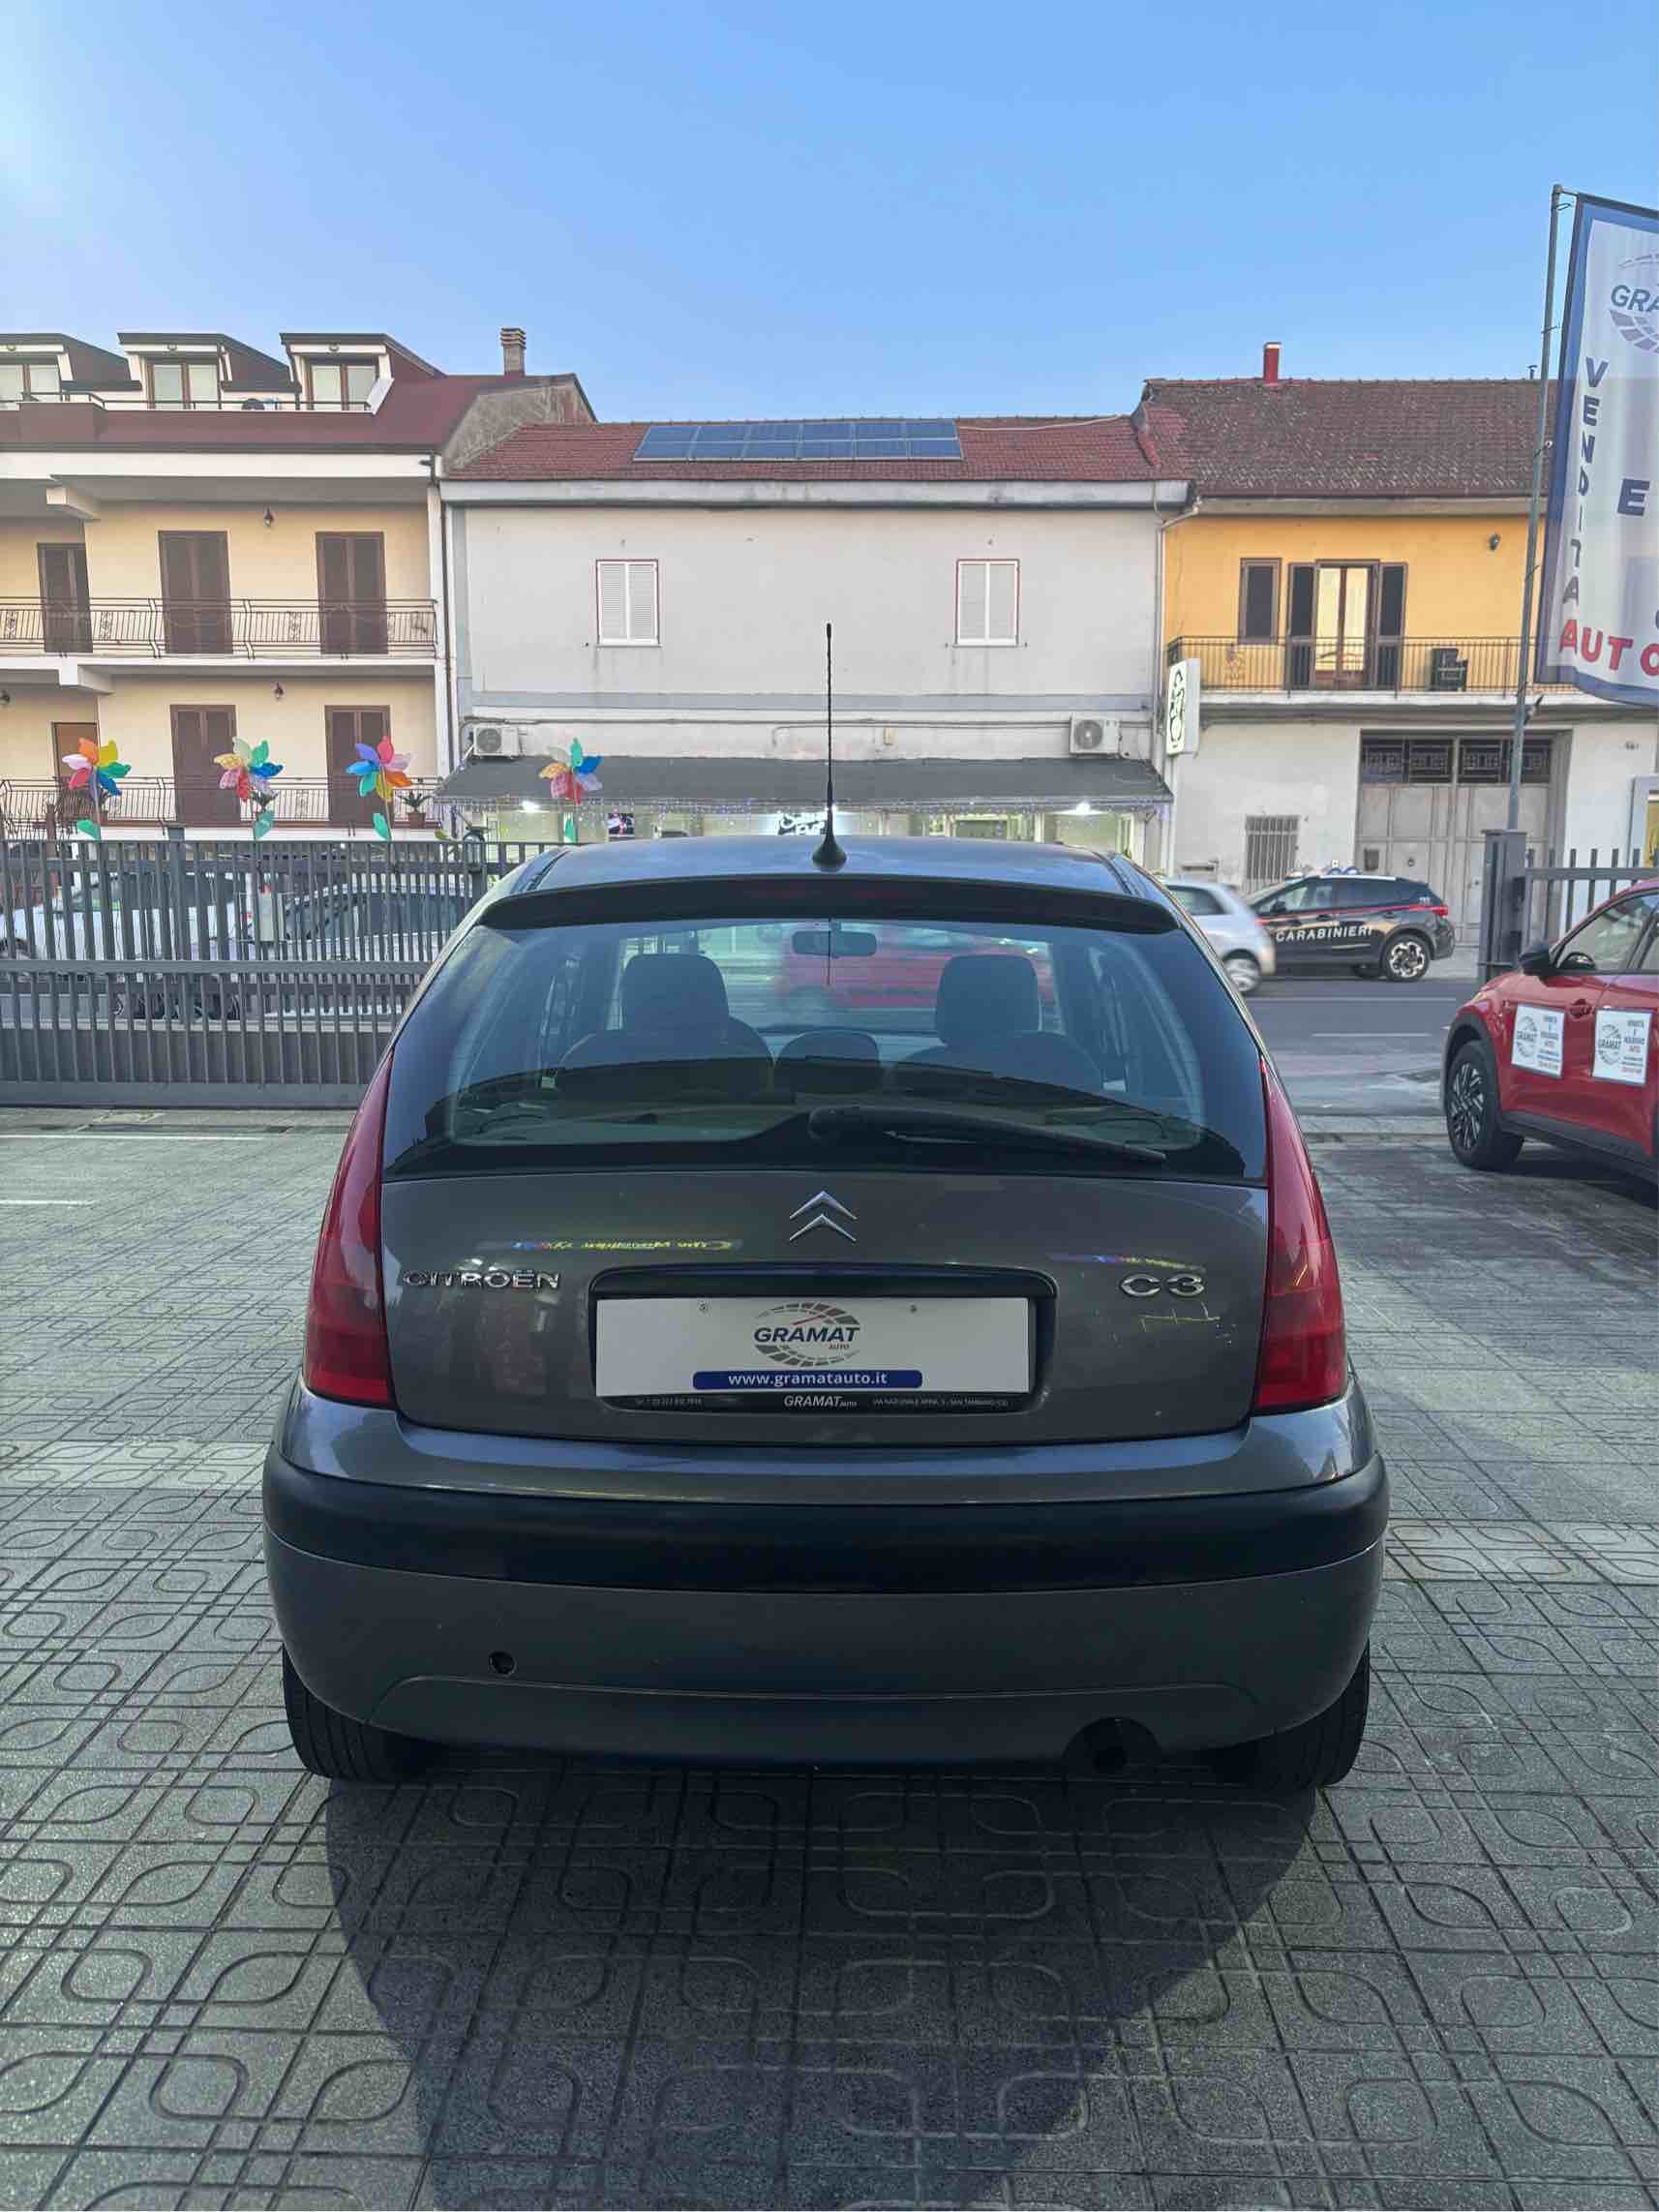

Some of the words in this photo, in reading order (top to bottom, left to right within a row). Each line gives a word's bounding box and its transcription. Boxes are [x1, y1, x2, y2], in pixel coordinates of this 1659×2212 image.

[1561, 356, 1609, 605] VENDITA
[1617, 478, 1649, 516] E
[1276, 924, 1372, 943] CARABINIERI
[403, 1269, 559, 1288] CITROËN
[1121, 1273, 1205, 1296] C3
[754, 1326, 860, 1343] GRAMAT
[728, 1372, 889, 1387] www.gramatauto.it
[784, 1395, 843, 1408] GRAMAT
